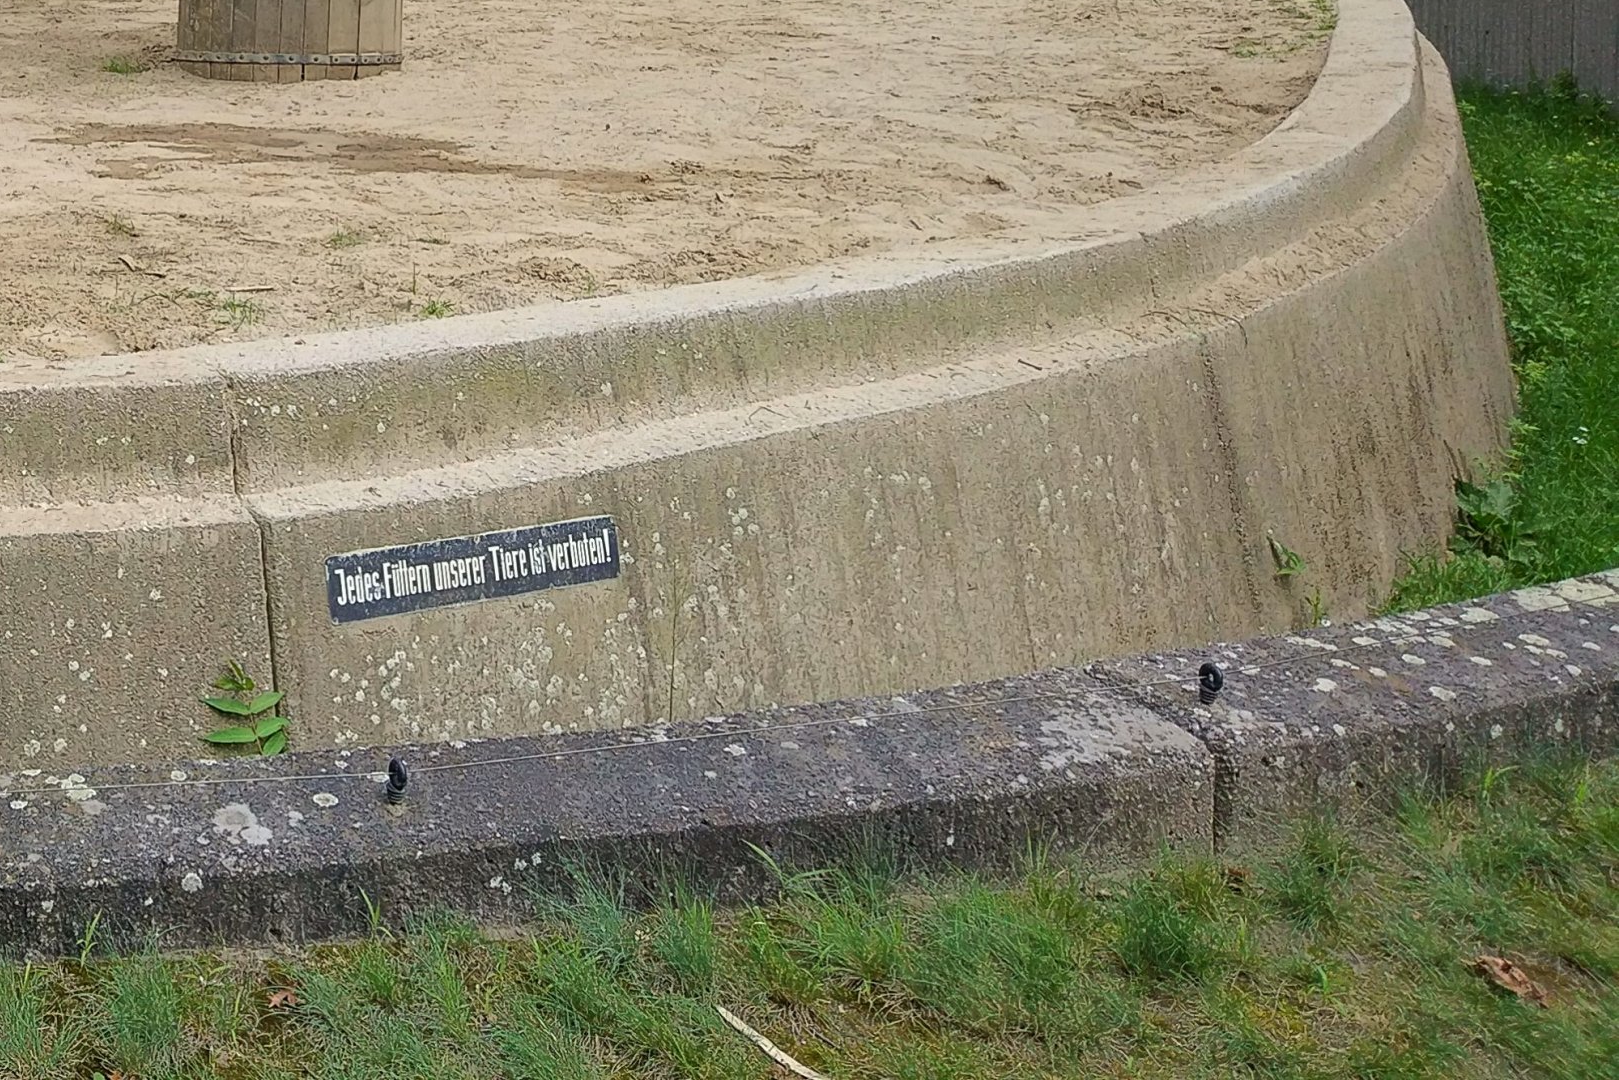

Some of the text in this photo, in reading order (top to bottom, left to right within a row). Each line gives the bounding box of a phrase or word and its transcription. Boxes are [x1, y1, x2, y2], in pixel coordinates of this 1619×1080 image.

[334, 528, 612, 606] Jedes Füttern unserer Tiere ist verboten!
